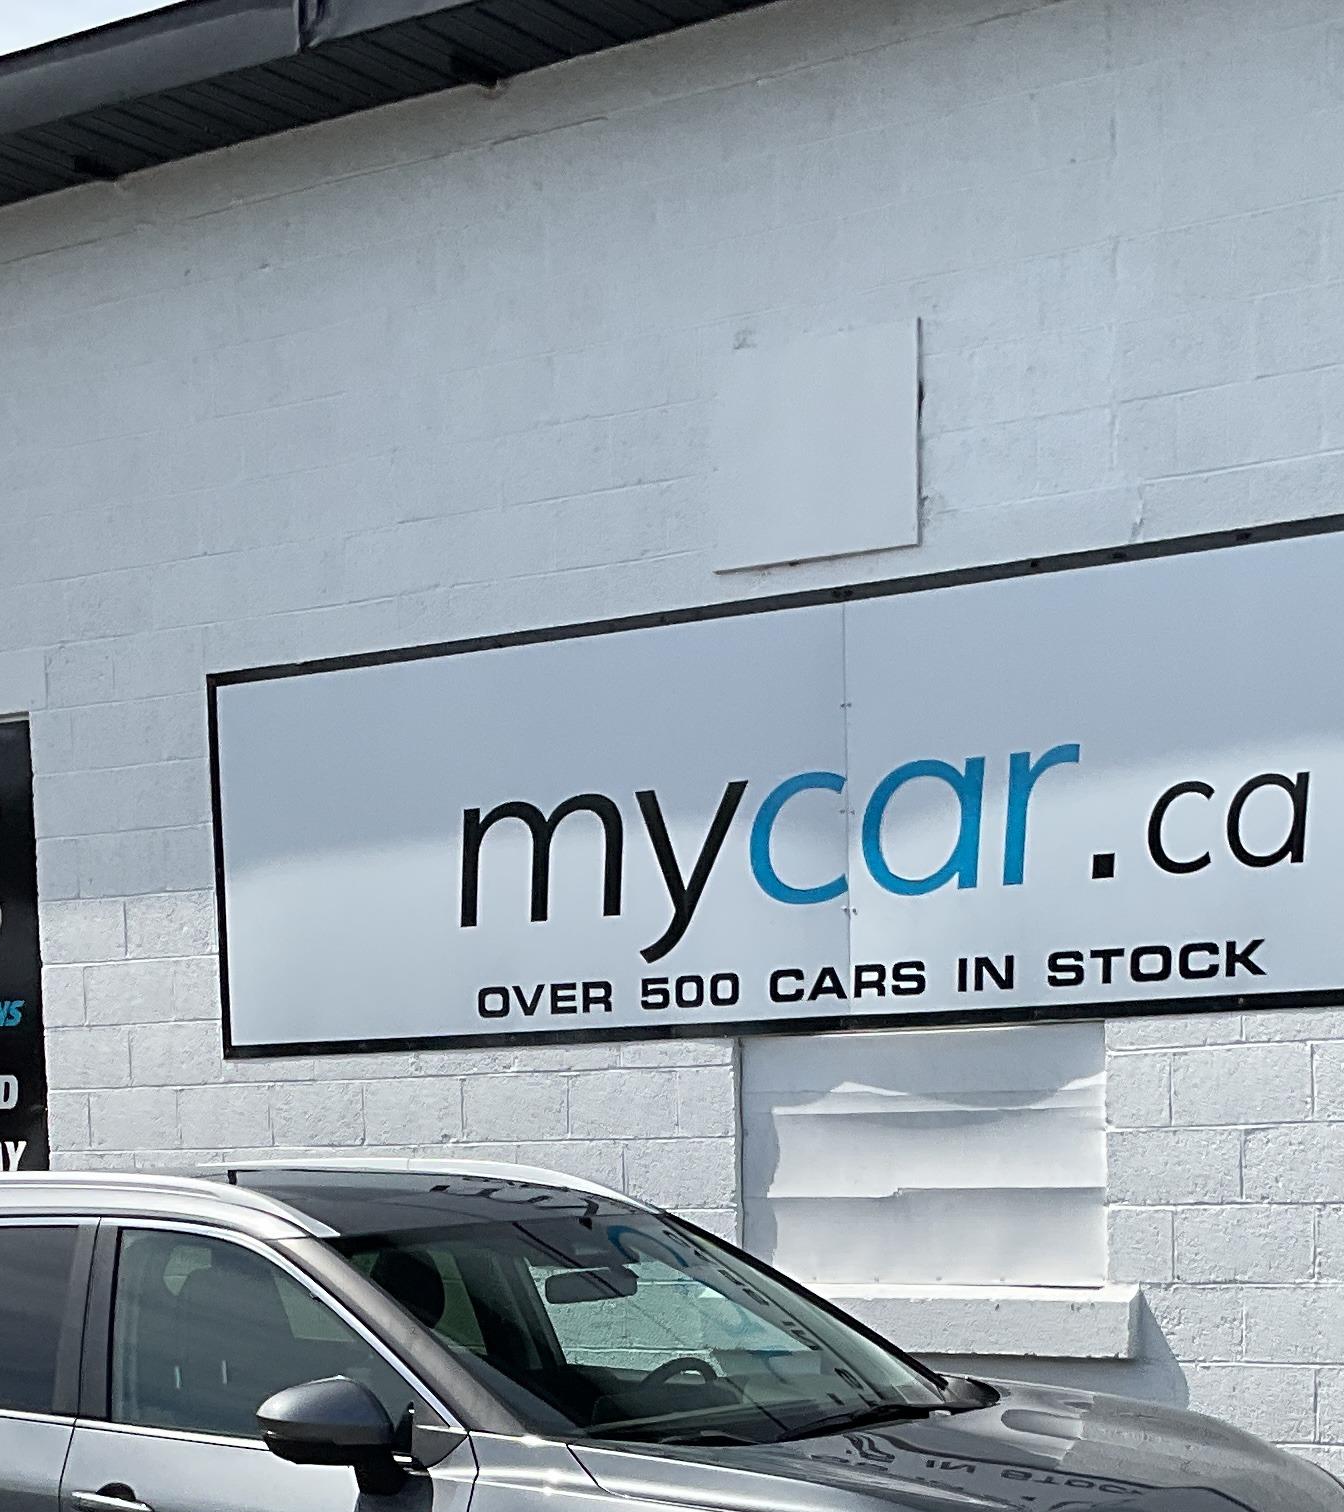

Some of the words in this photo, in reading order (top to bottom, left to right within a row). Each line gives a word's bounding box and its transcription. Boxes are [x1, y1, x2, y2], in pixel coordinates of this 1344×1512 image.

[460, 743, 1311, 963] mycar.ca
[476, 981, 613, 1019] OVER
[640, 973, 741, 1010] 500
[769, 958, 927, 1003] CARS
[957, 954, 1015, 994] IN
[1047, 939, 1268, 986] STOCK
